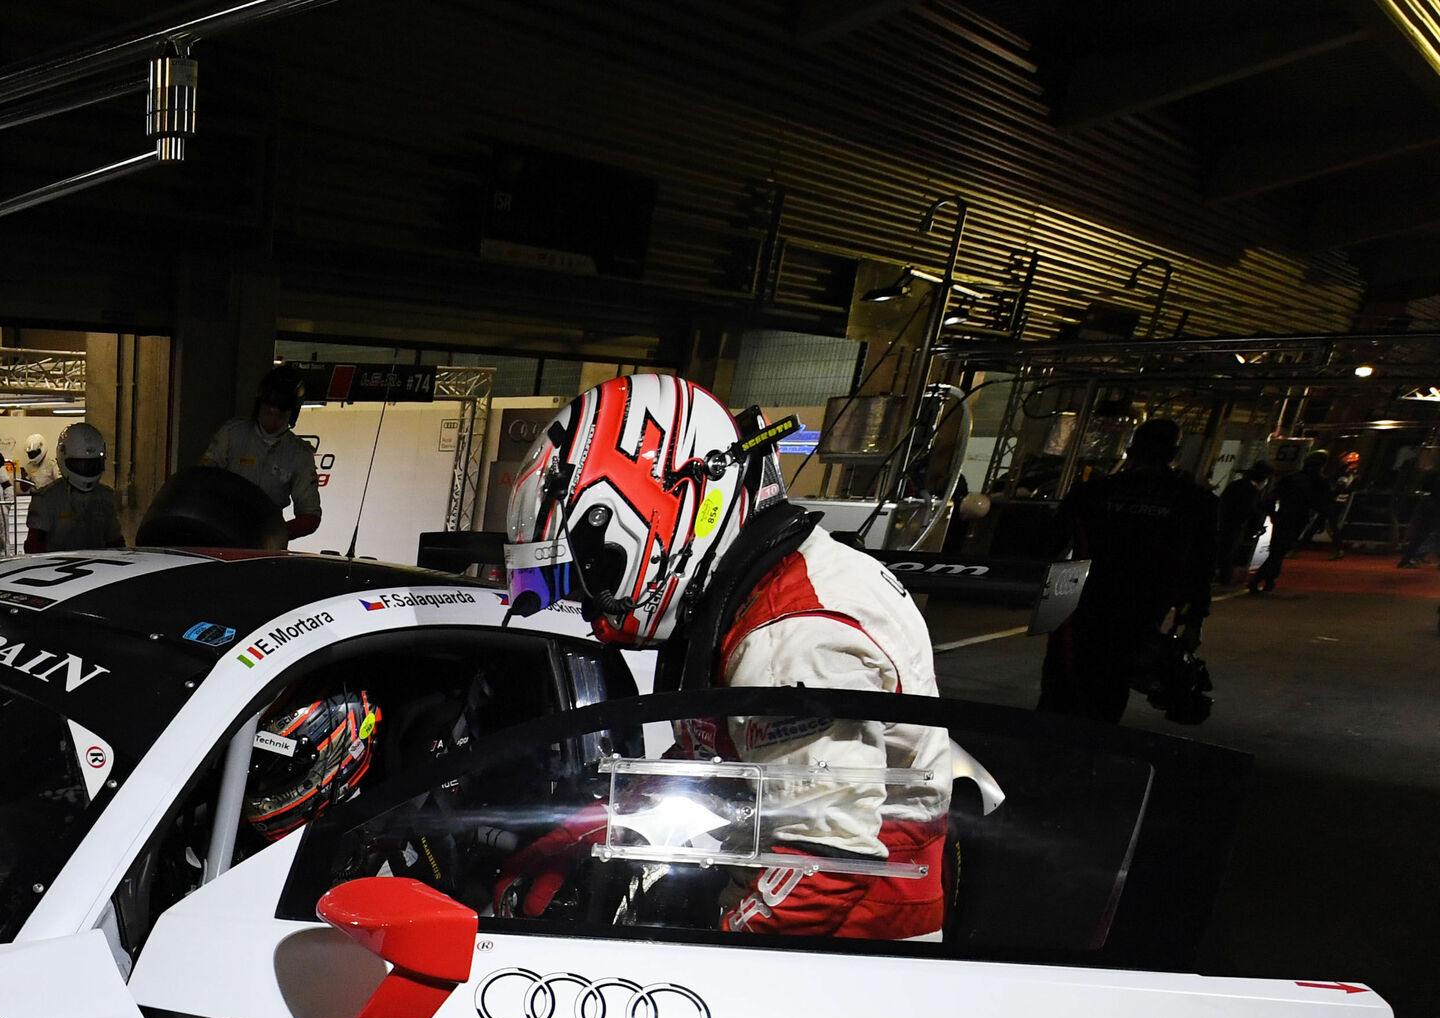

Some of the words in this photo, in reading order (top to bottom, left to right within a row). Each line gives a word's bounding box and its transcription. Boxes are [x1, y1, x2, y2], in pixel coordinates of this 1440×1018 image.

[406, 373, 431, 393] #74
[706, 505, 719, 525] 854
[253, 609, 336, 656] E.Mortara
[254, 733, 292, 752] Technik
